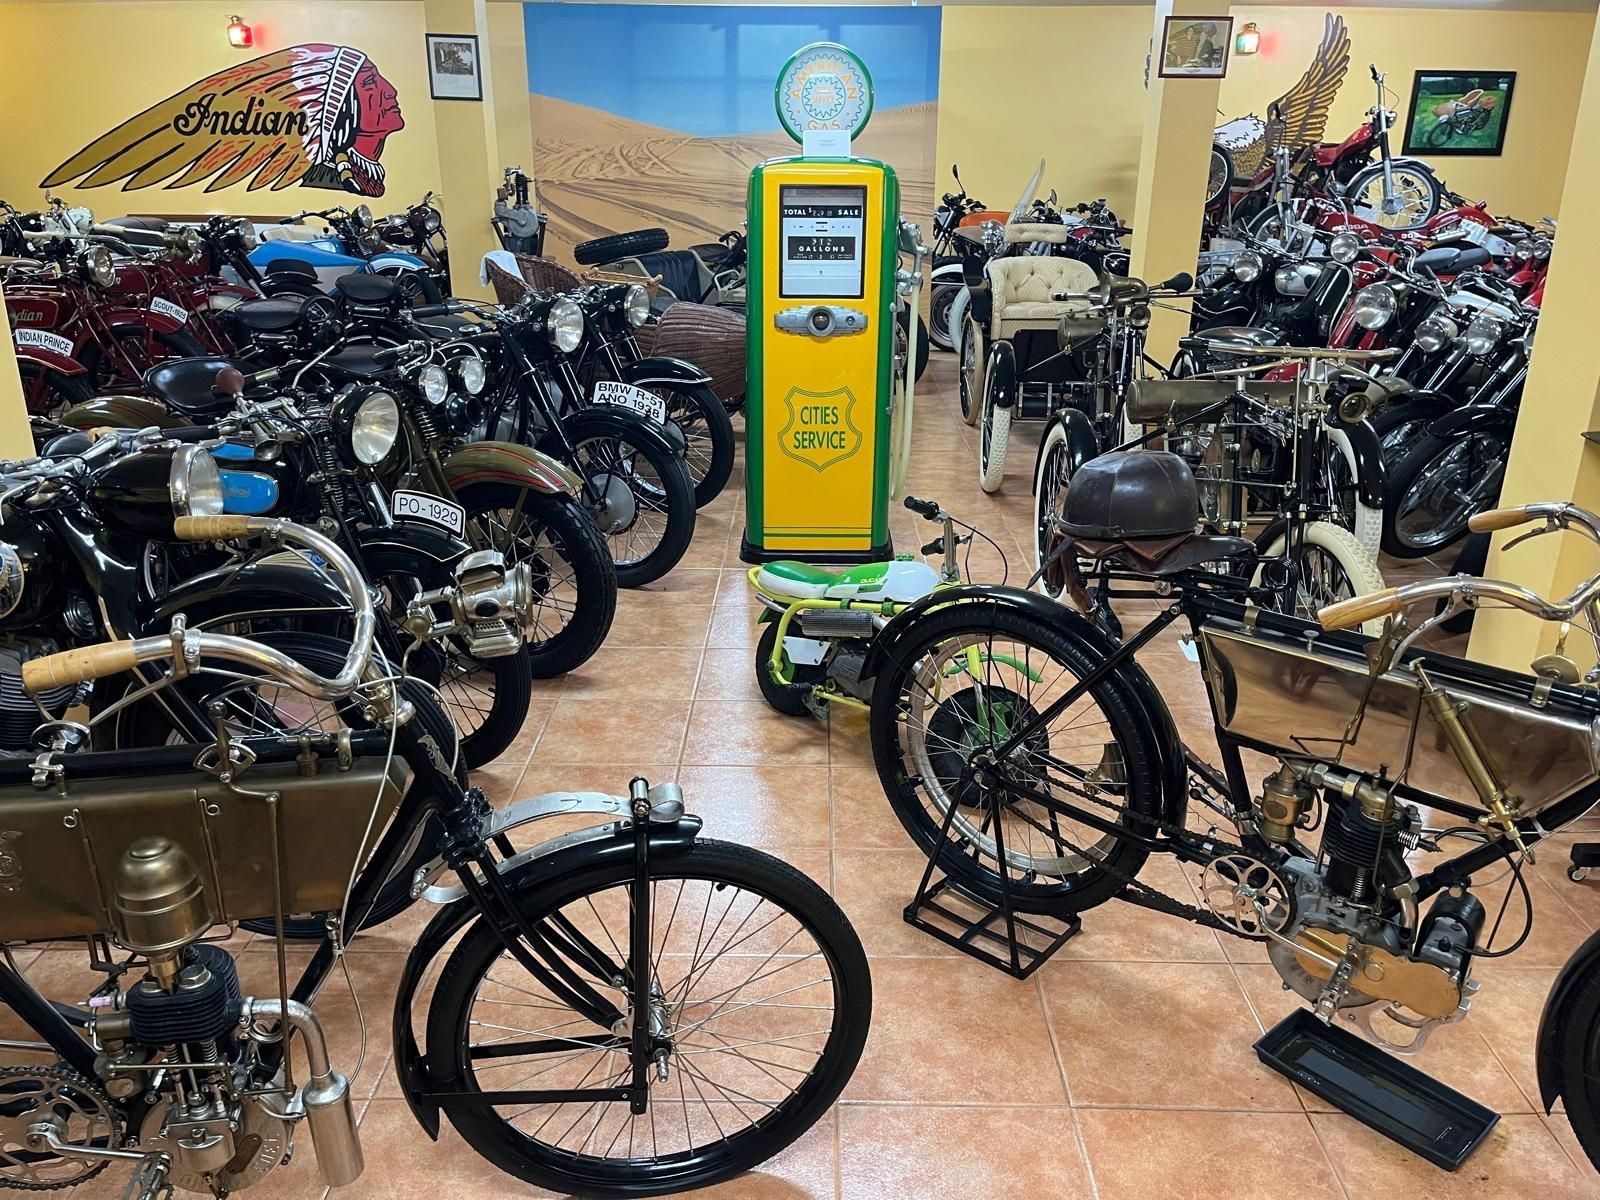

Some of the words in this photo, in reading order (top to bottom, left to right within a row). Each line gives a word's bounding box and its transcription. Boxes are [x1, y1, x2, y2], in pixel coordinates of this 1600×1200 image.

[792, 60, 857, 99] AMERICAN
[173, 93, 309, 136] Indian
[808, 120, 841, 130] GAS
[17, 309, 43, 321] dian
[19, 332, 42, 343] INDIAN
[44, 335, 70, 353] PRINCE
[598, 382, 632, 395] BMW
[636, 389, 663, 410] R-51
[632, 399, 660, 419] 1938
[800, 406, 839, 425] CITIES
[793, 430, 846, 449] SERVICE
